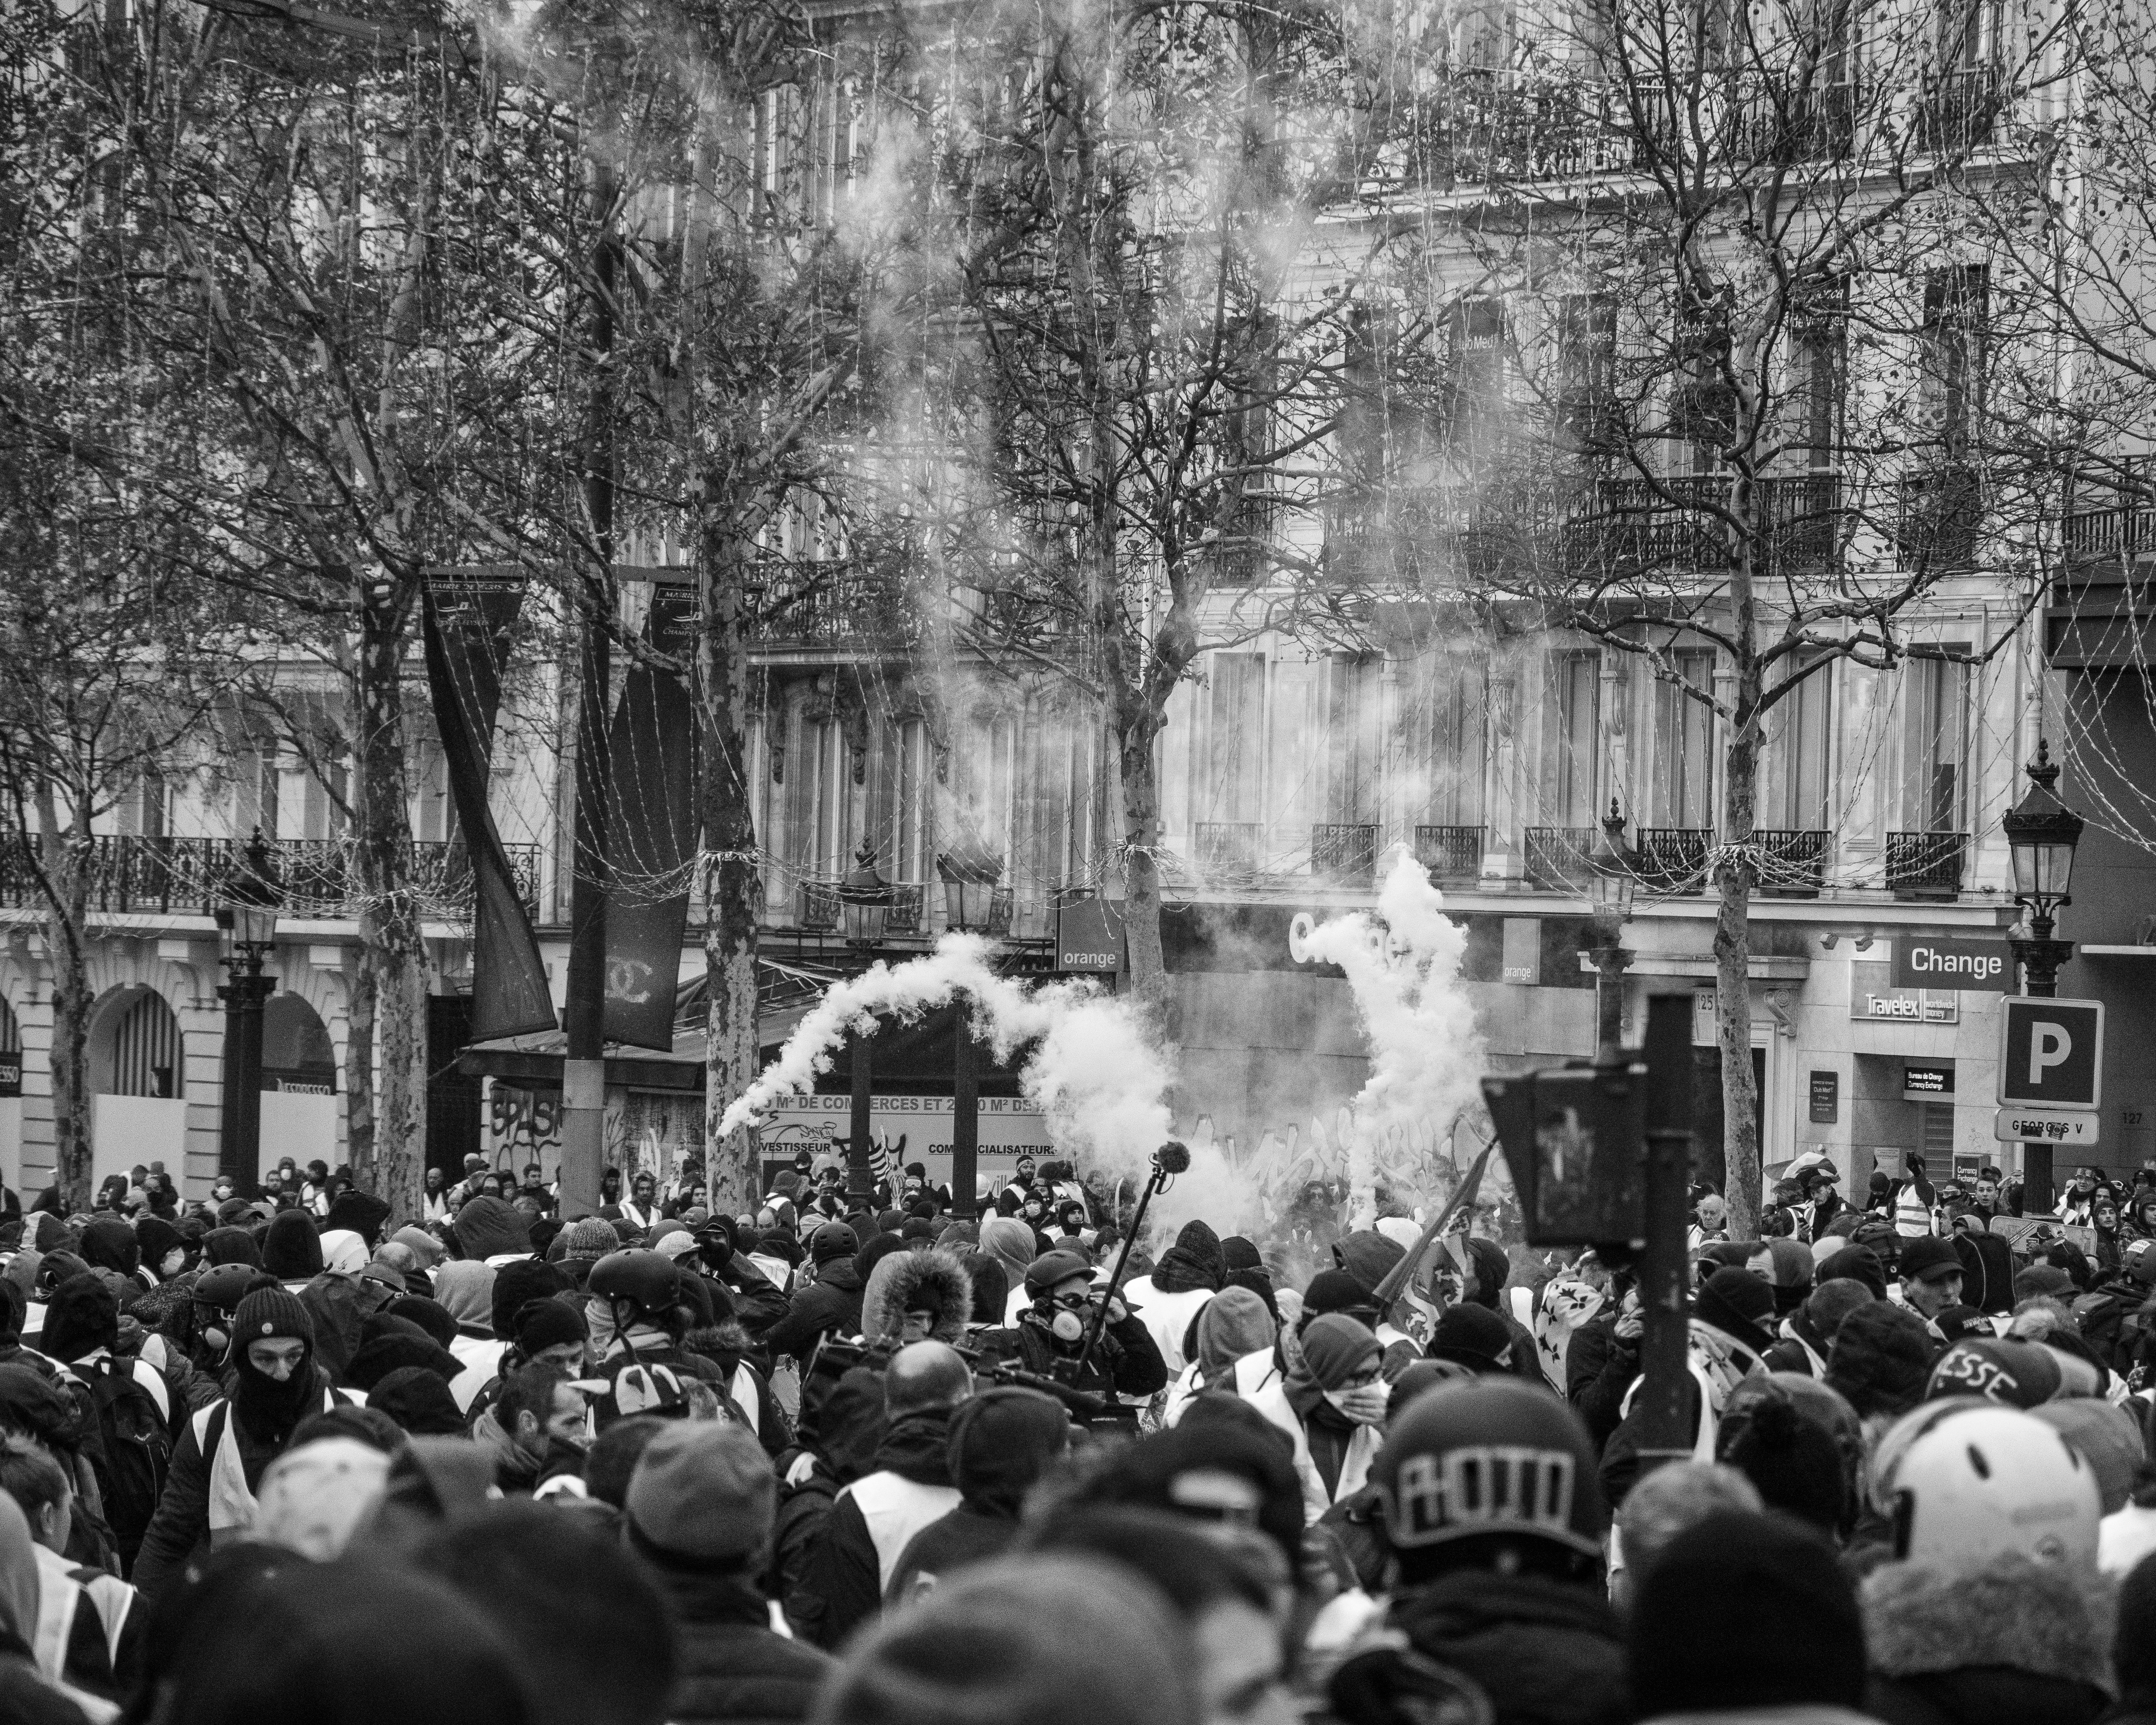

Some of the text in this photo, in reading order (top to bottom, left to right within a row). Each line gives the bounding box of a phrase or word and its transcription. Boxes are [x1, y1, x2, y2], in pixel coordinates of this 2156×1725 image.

[1474, 334, 1493, 349] Med
[1064, 953, 1116, 968] orange
[1912, 948, 2002, 979] Change
[1504, 966, 1531, 980] orange
[1697, 994, 1713, 1010] 125
[1865, 993, 1919, 1016] Travelex
[1925, 1000, 1955, 1009] worldwide
[1925, 1010, 1945, 1019] money
[2029, 1022, 2071, 1084] P
[1928, 1073, 1943, 1082] Change
[1908, 1081, 1943, 1091] Currency Exchange
[799, 1097, 818, 1108] DE
[924, 1098, 943, 1111] ET
[2123, 1113, 2143, 1124] 127
[2075, 1123, 2083, 1134] V
[760, 1142, 830, 1152] VESTISSEUR
[1958, 1166, 1977, 1176] Currency
[1957, 1174, 1978, 1184] Exchange
